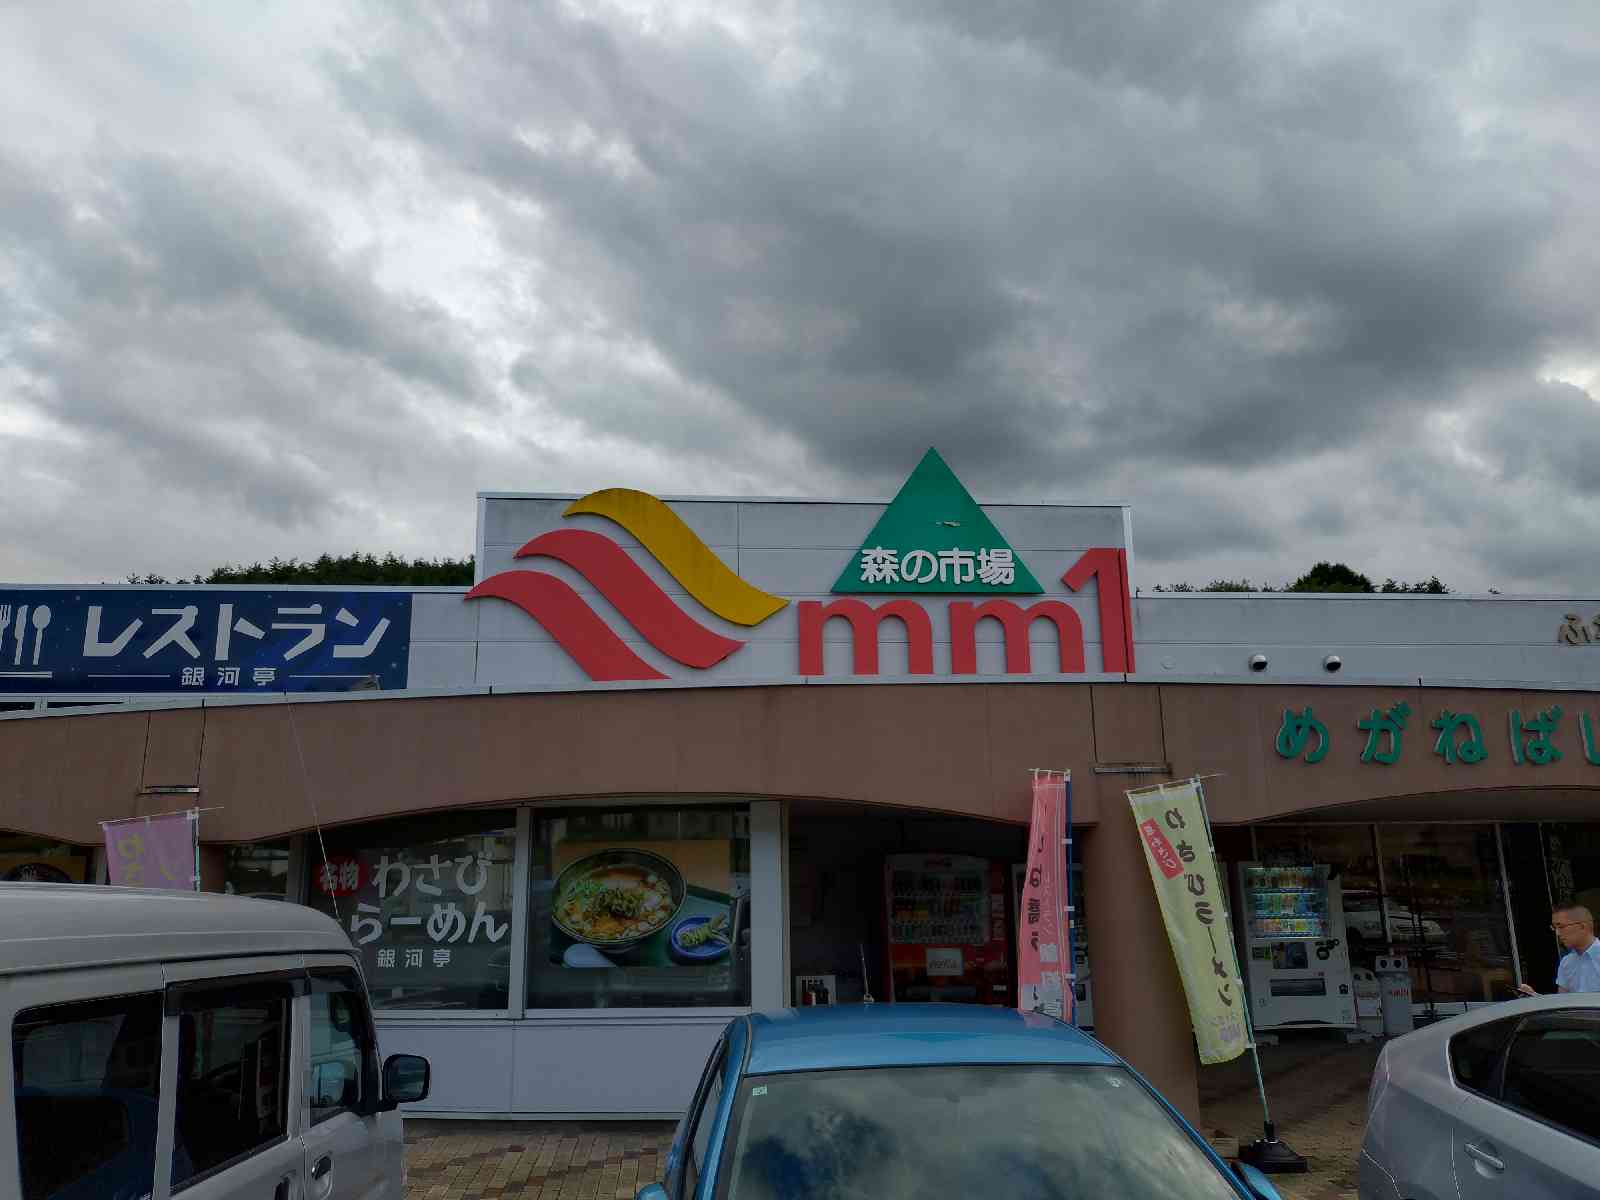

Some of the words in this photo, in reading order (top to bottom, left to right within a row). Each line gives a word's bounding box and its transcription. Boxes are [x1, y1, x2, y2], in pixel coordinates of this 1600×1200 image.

[859, 546, 1017, 585] 森の市場
[82, 602, 392, 661] レストラン
[180, 667, 278, 687] 銀河亭
[371, 853, 493, 897] わさび
[350, 901, 509, 944] らーめん
[376, 948, 452, 969] 銀河亭
